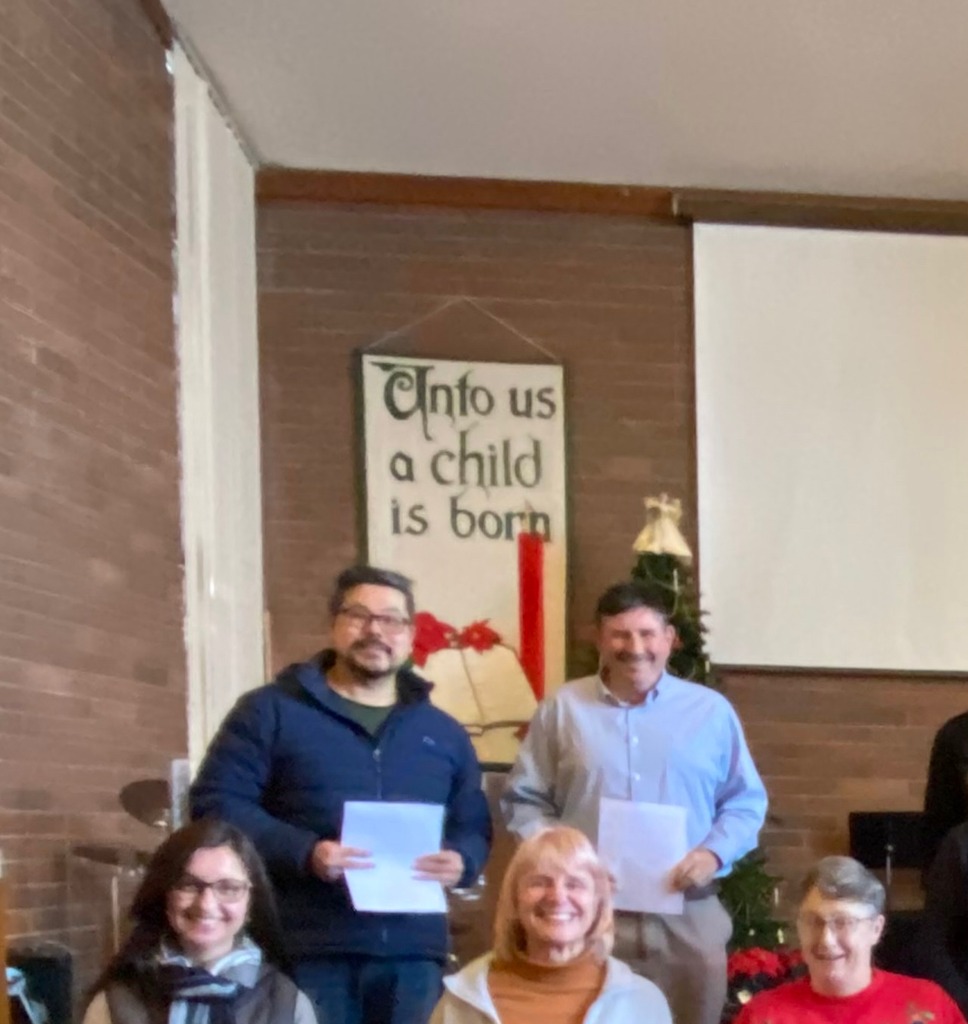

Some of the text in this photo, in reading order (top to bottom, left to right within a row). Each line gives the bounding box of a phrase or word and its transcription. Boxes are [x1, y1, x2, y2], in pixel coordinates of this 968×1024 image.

[370, 361, 557, 441] Unto us
[390, 421, 542, 499] a child
[391, 490, 552, 543] is born
